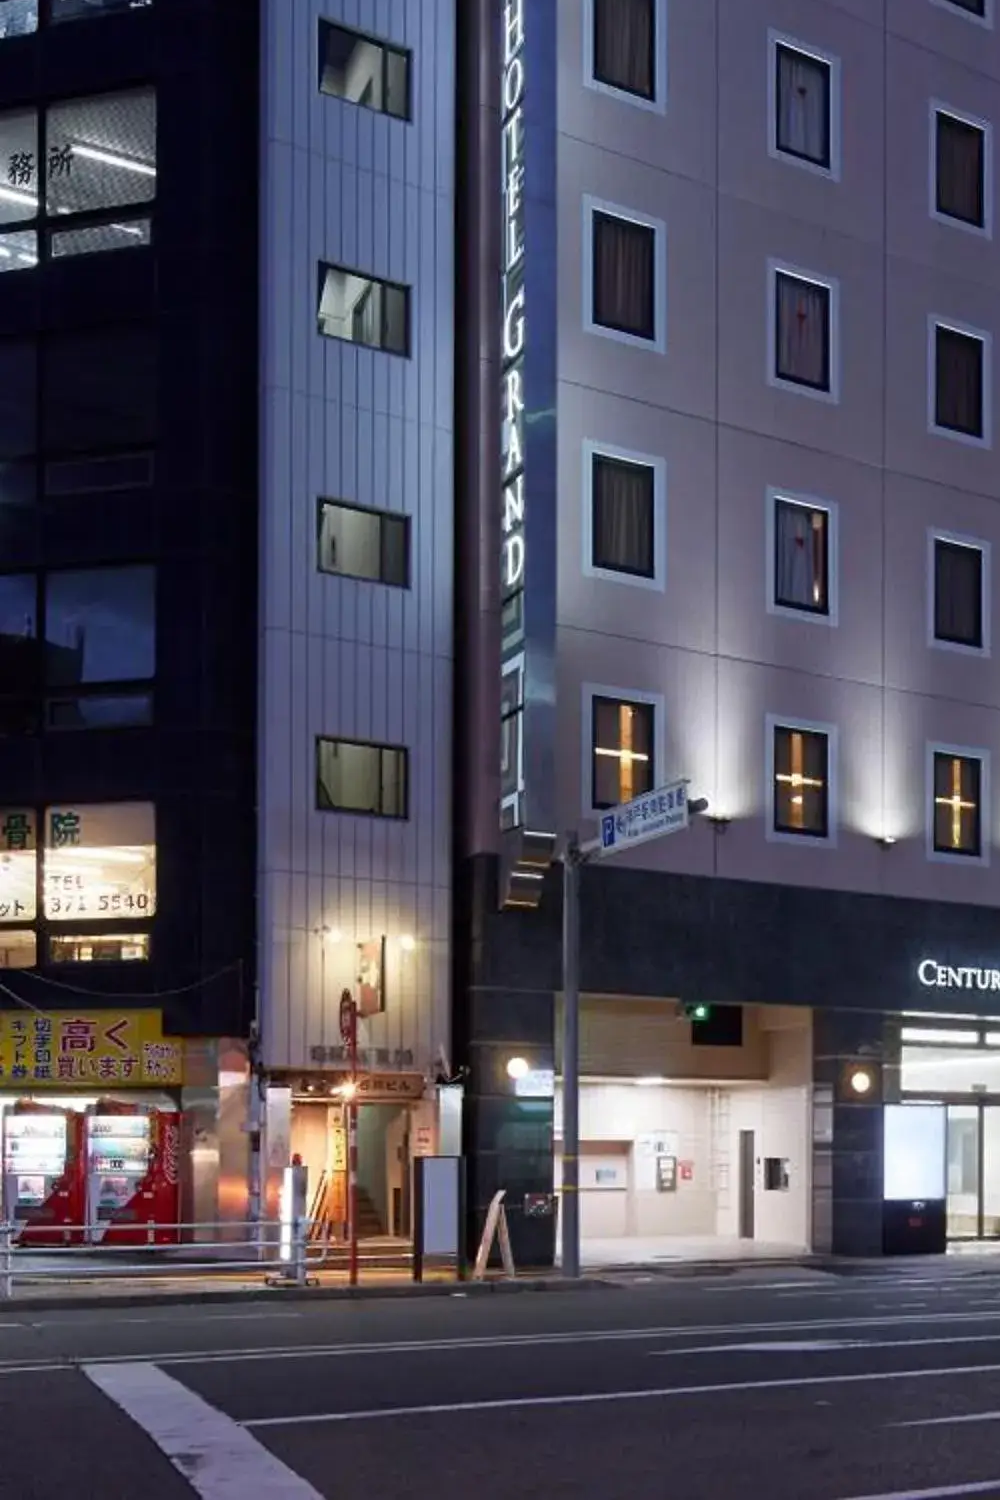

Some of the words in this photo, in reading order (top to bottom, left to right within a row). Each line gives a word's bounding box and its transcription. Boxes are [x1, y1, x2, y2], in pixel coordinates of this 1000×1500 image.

[502, 284, 526, 590] GRAND
[61, 1019, 129, 1053] 高く
[57, 1056, 139, 1080] 買います
